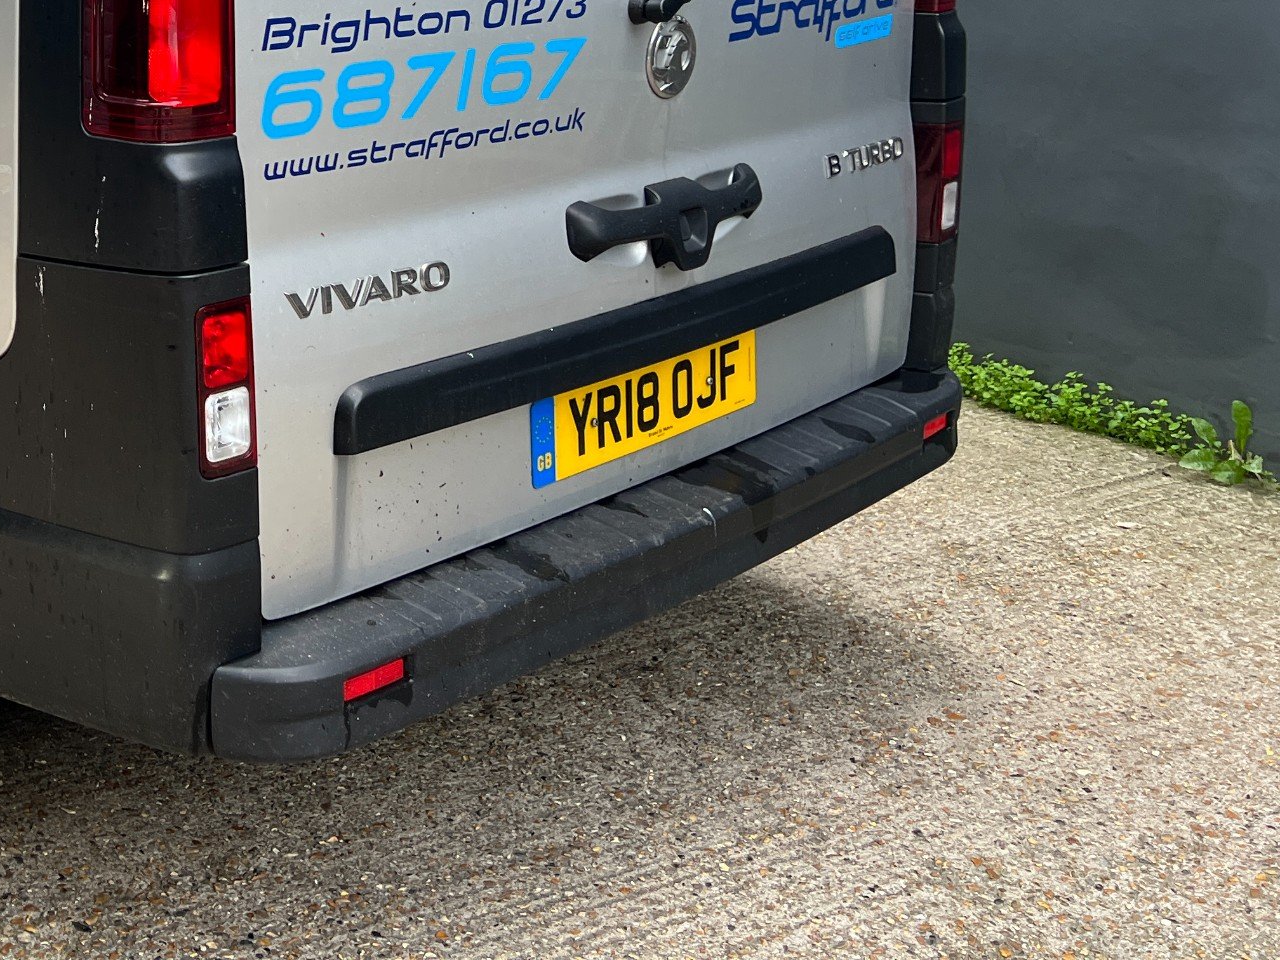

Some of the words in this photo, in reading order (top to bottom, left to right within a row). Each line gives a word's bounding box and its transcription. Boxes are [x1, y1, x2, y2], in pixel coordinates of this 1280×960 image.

[261, 7, 471, 53] Brighton
[261, 37, 588, 140] 687167
[263, 107, 586, 181] www.strafford.co.uk
[842, 136, 904, 174] TURBO
[283, 261, 451, 319] VIVARO
[569, 371, 660, 457] YR18
[672, 340, 739, 419] OJF
[536, 452, 552, 472] GB
